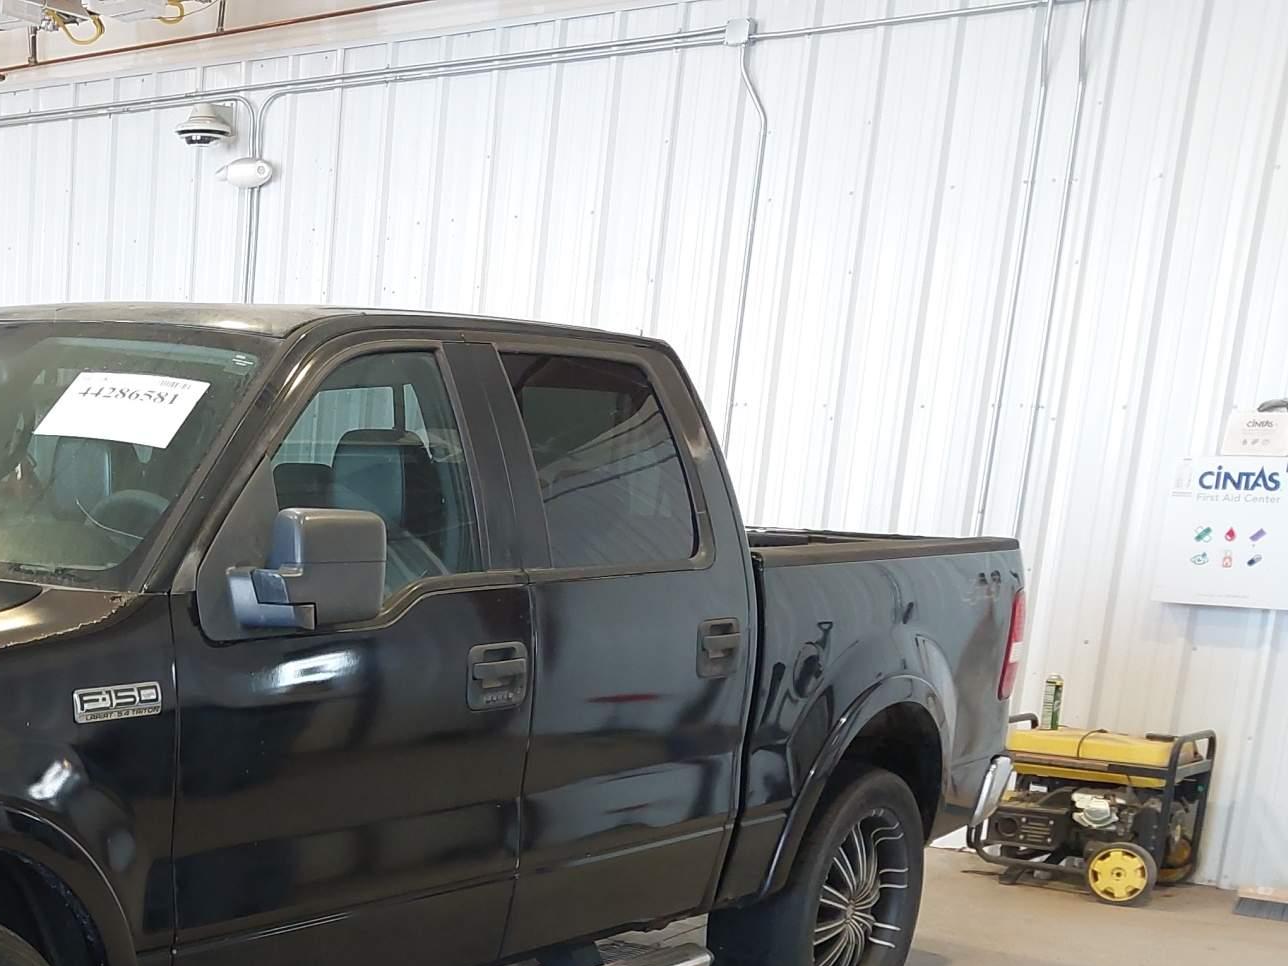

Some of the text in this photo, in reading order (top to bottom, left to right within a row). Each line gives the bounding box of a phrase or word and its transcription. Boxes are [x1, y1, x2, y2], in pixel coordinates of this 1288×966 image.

[79, 386, 179, 405] 44286581
[1198, 465, 1281, 492] CINTAS
[1197, 493, 1281, 504] First Aid Center
